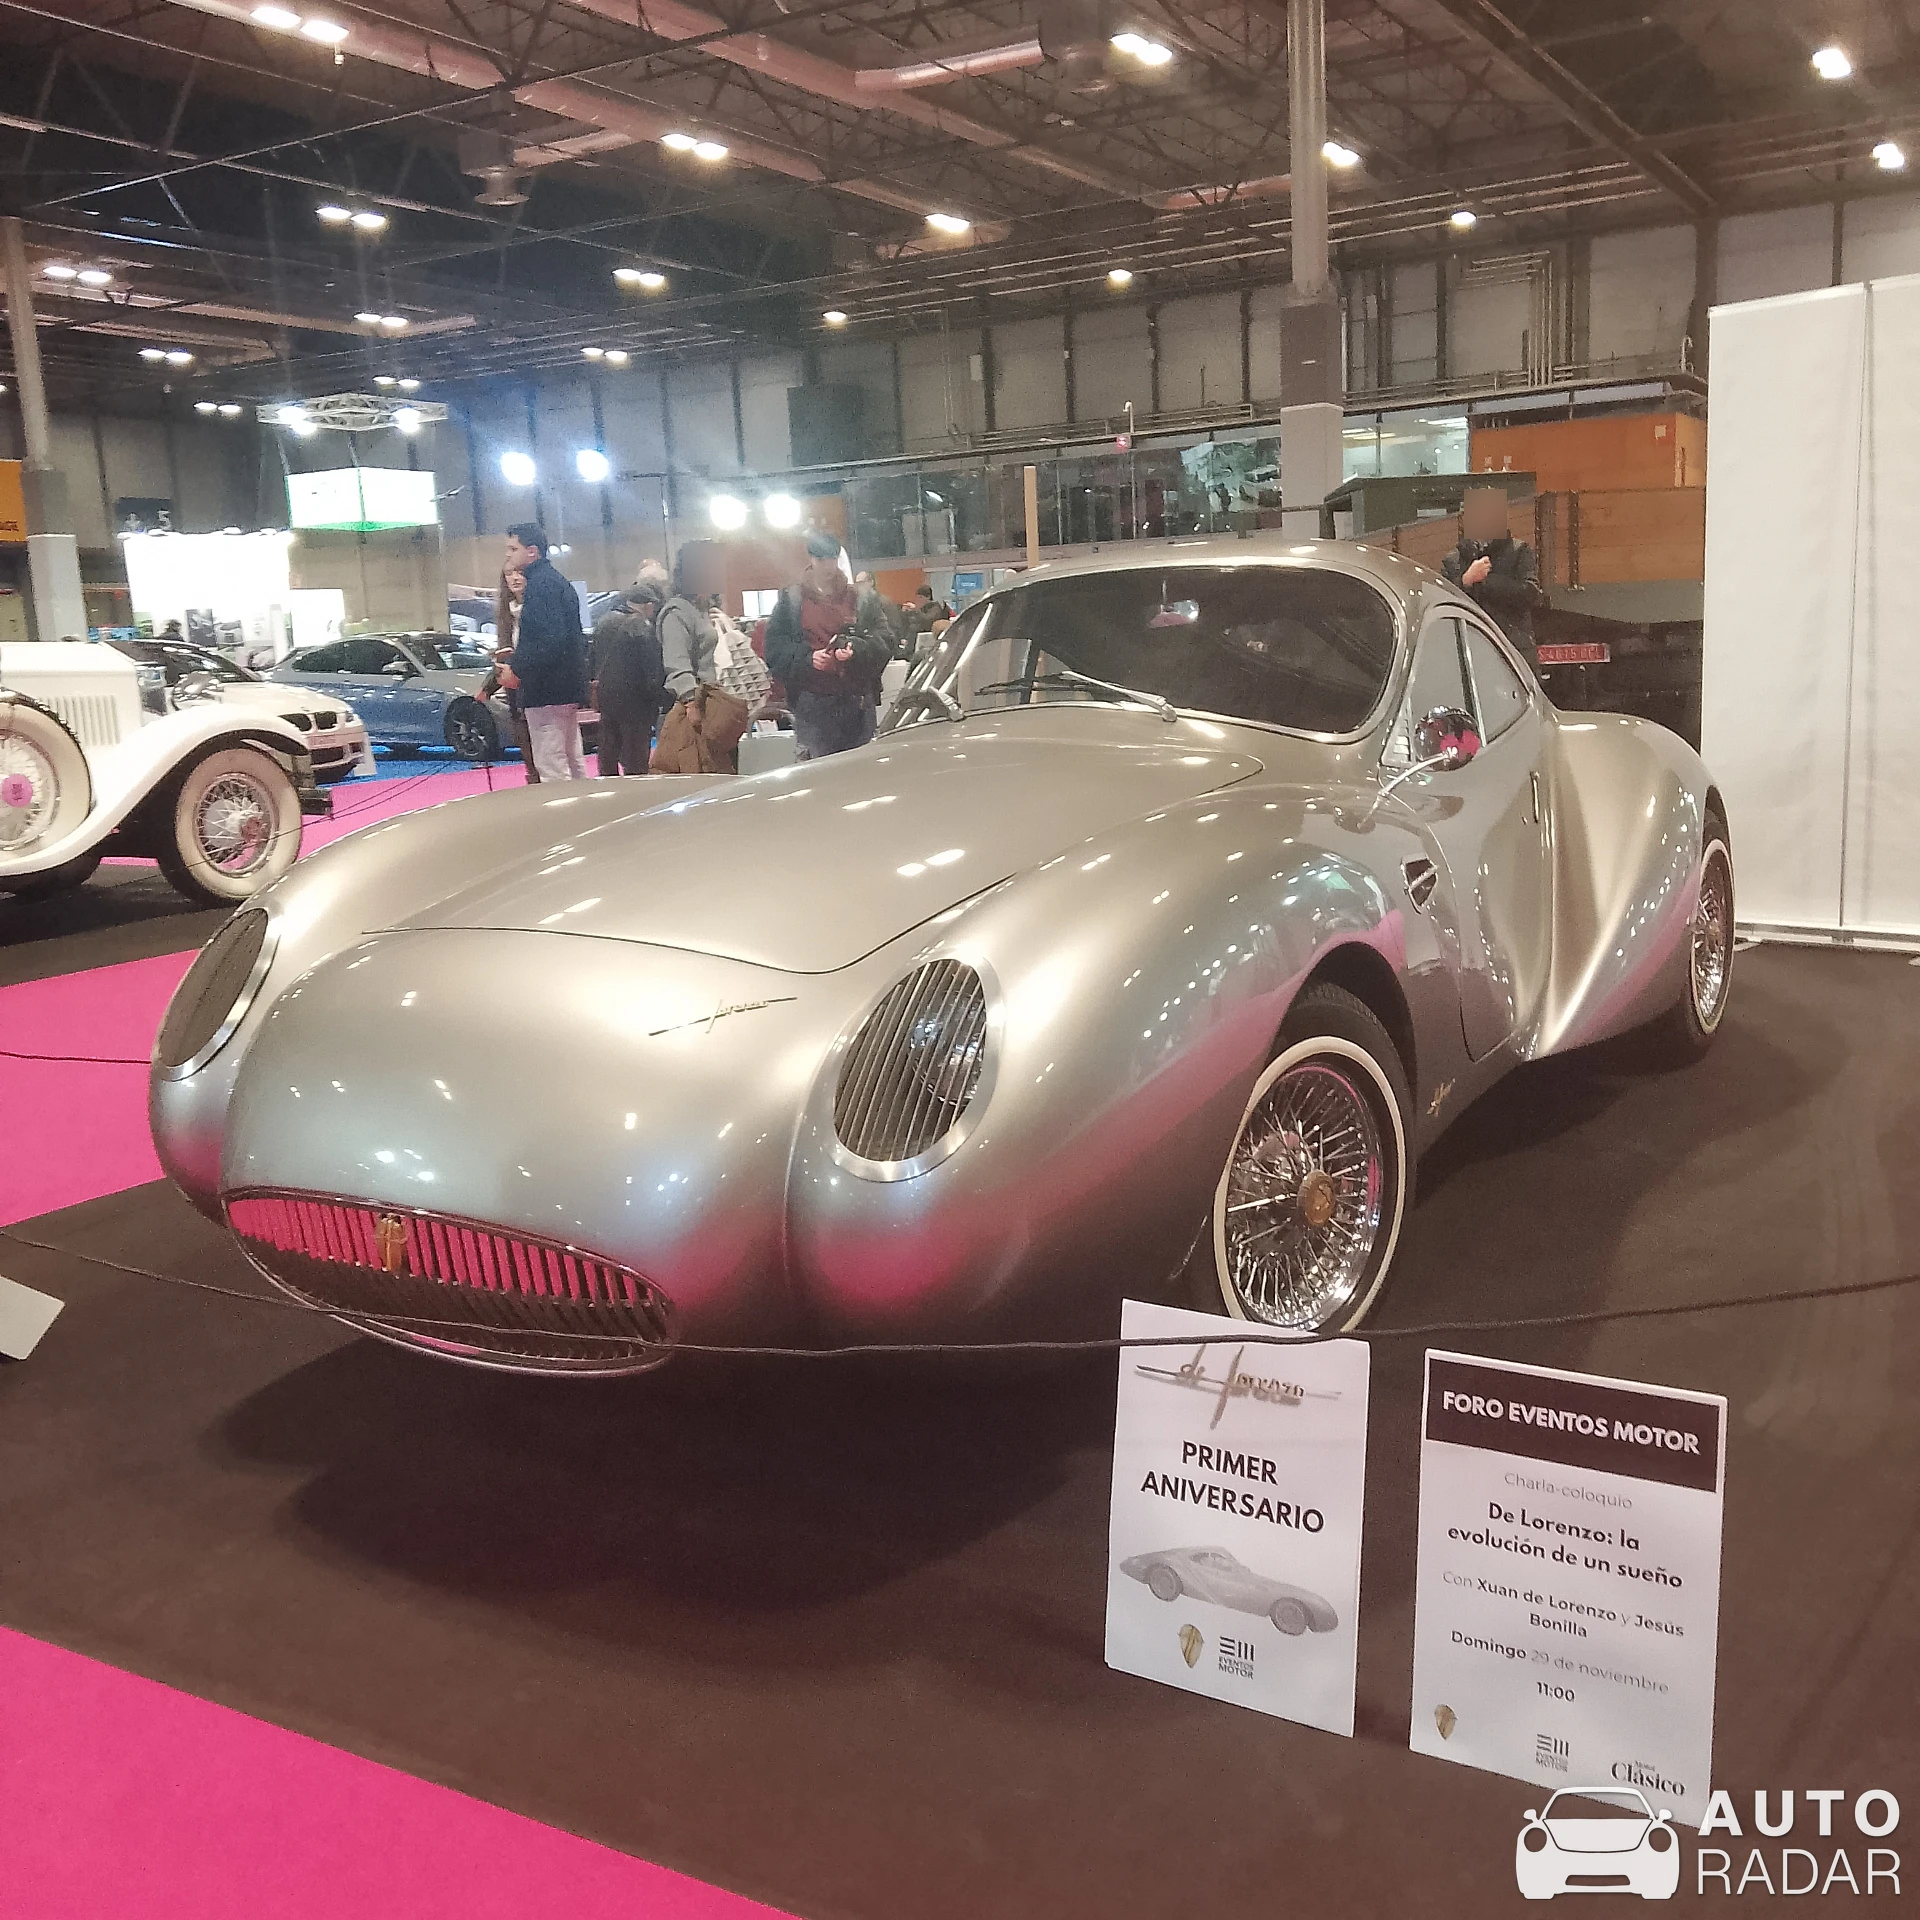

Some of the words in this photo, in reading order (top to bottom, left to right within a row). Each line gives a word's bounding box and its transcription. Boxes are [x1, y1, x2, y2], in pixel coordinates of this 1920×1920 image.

[1442, 1391, 1504, 1419] FORO
[1508, 1402, 1609, 1439] EVENTOS
[1613, 1421, 1701, 1455] MOTOR
[1181, 1440, 1279, 1486] PRIMER
[1140, 1471, 1324, 1533] ANIVERSARIO
[1504, 1473, 1633, 1510] Charla-coloquio
[1488, 1501, 1515, 1524] De
[1520, 1509, 1613, 1545] Lorenzo:
[1620, 1528, 1640, 1551] la
[1447, 1526, 1545, 1559] evolución
[1551, 1545, 1578, 1567] de
[1584, 1556, 1610, 1574] un
[1617, 1566, 1683, 1588] sueño
[1442, 1571, 1473, 1588] Con
[1476, 1578, 1518, 1600] Xuan
[1522, 1590, 1544, 1605] de
[1549, 1595, 1617, 1622] Lorenzo
[1620, 1613, 1630, 1628] y
[1529, 1612, 1588, 1638] Bonilla
[1218, 1663, 1254, 1680] MOTOR
[1451, 1630, 1527, 1659] Domingo
[1531, 1650, 1549, 1665] 29
[1554, 1656, 1574, 1671] de
[1578, 1664, 1669, 1694] noviembre
[1536, 1681, 1575, 1702] 11:00
